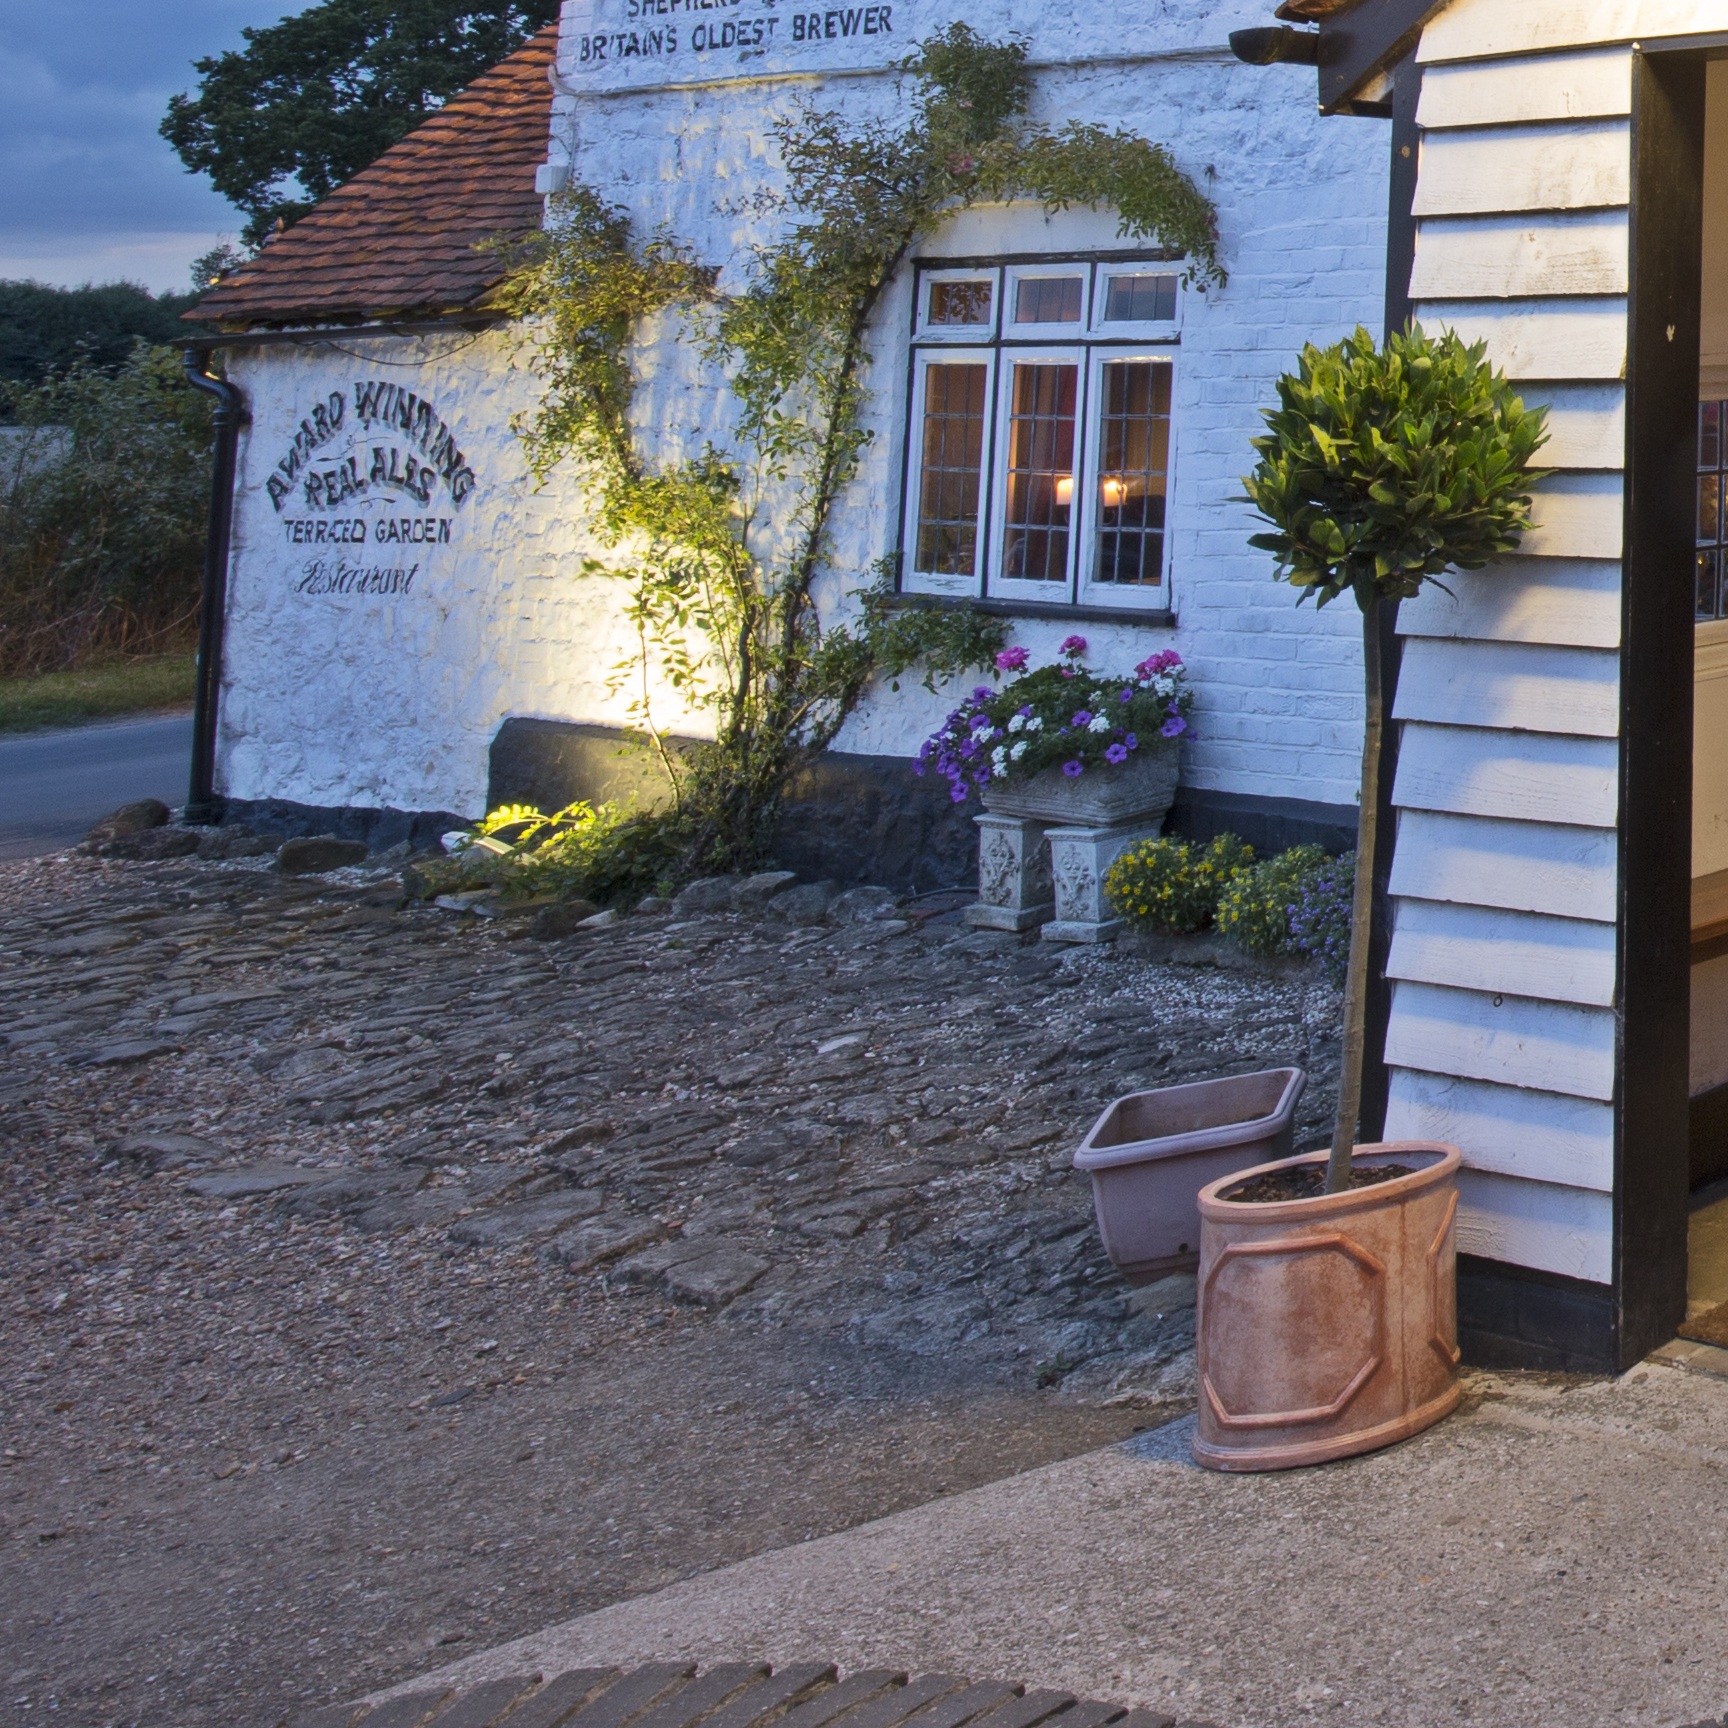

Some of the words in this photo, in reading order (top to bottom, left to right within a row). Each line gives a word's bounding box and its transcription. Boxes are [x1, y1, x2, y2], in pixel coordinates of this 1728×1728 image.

[691, 16, 779, 52] OLDEST
[793, 5, 892, 41] BREWER
[265, 391, 347, 513] AWARD
[355, 381, 476, 512] WINNING
[303, 455, 366, 511] REAL
[370, 446, 436, 508] ALES
[285, 519, 364, 543] TERRACED
[375, 518, 453, 543] GARDEN
